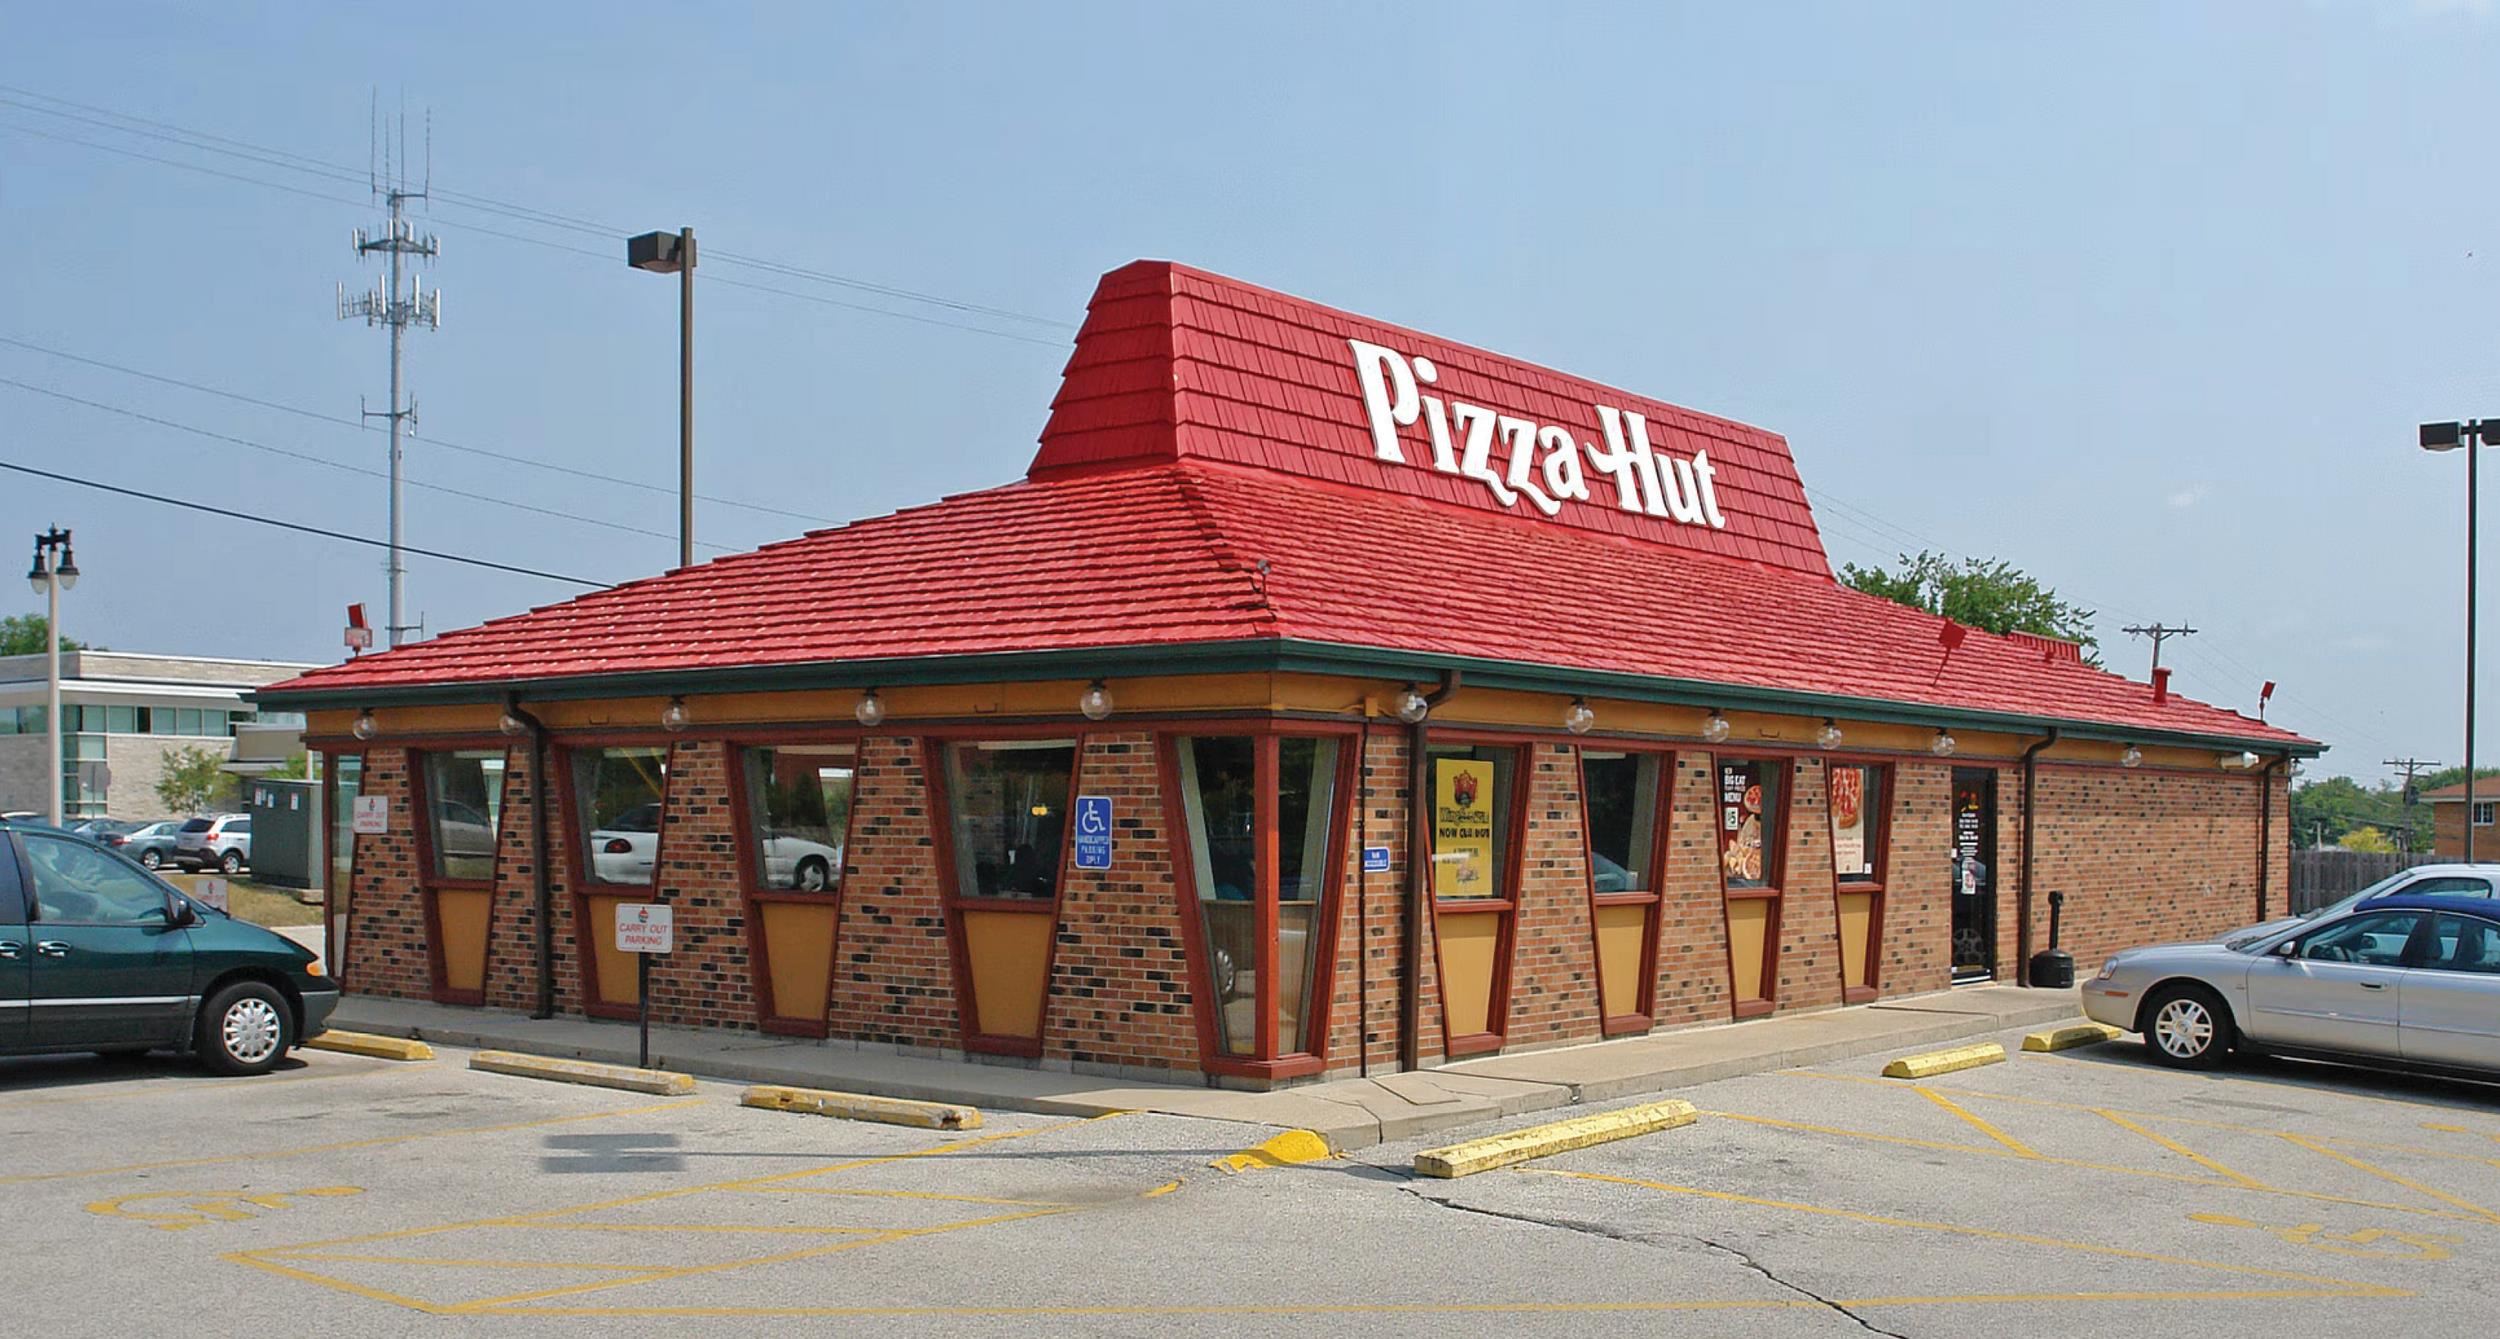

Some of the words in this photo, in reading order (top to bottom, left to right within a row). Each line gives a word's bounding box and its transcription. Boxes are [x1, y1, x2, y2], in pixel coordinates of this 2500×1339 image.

[1347, 338, 1590, 516] Pizza
[1584, 405, 1726, 529] Hut
[1724, 775, 1734, 785] BIG
[619, 923, 646, 933] CARRY
[650, 924, 668, 934] OUT
[624, 935, 662, 945] PARKING
